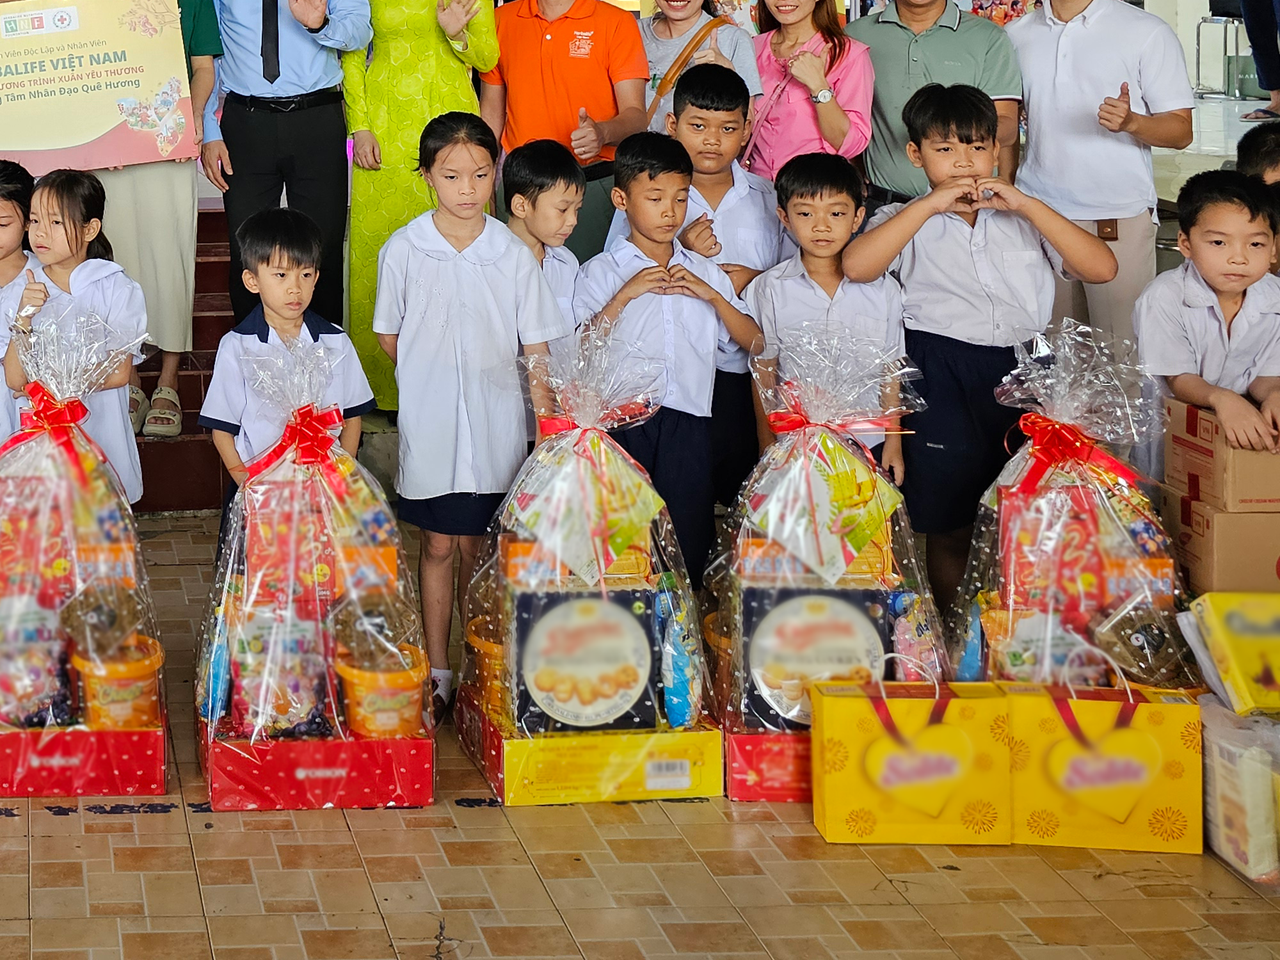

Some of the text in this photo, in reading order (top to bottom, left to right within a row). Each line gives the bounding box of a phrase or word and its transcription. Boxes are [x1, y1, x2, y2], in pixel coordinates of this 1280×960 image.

[23, 47, 39, 57] Độc
[40, 46, 55, 55] Lập
[49, 53, 84, 72] VIỆT
[88, 50, 127, 66] NAM
[28, 76, 56, 87] TRÌNH
[58, 72, 83, 83] XUÂN
[85, 70, 103, 80] YÊU
[104, 65, 145, 77] THƯƠNG
[4, 92, 26, 102] Tâm
[28, 89, 57, 99] Nhân
[58, 86, 79, 96] Đạo
[81, 81, 103, 94] Quê
[105, 79, 140, 90] Hương
